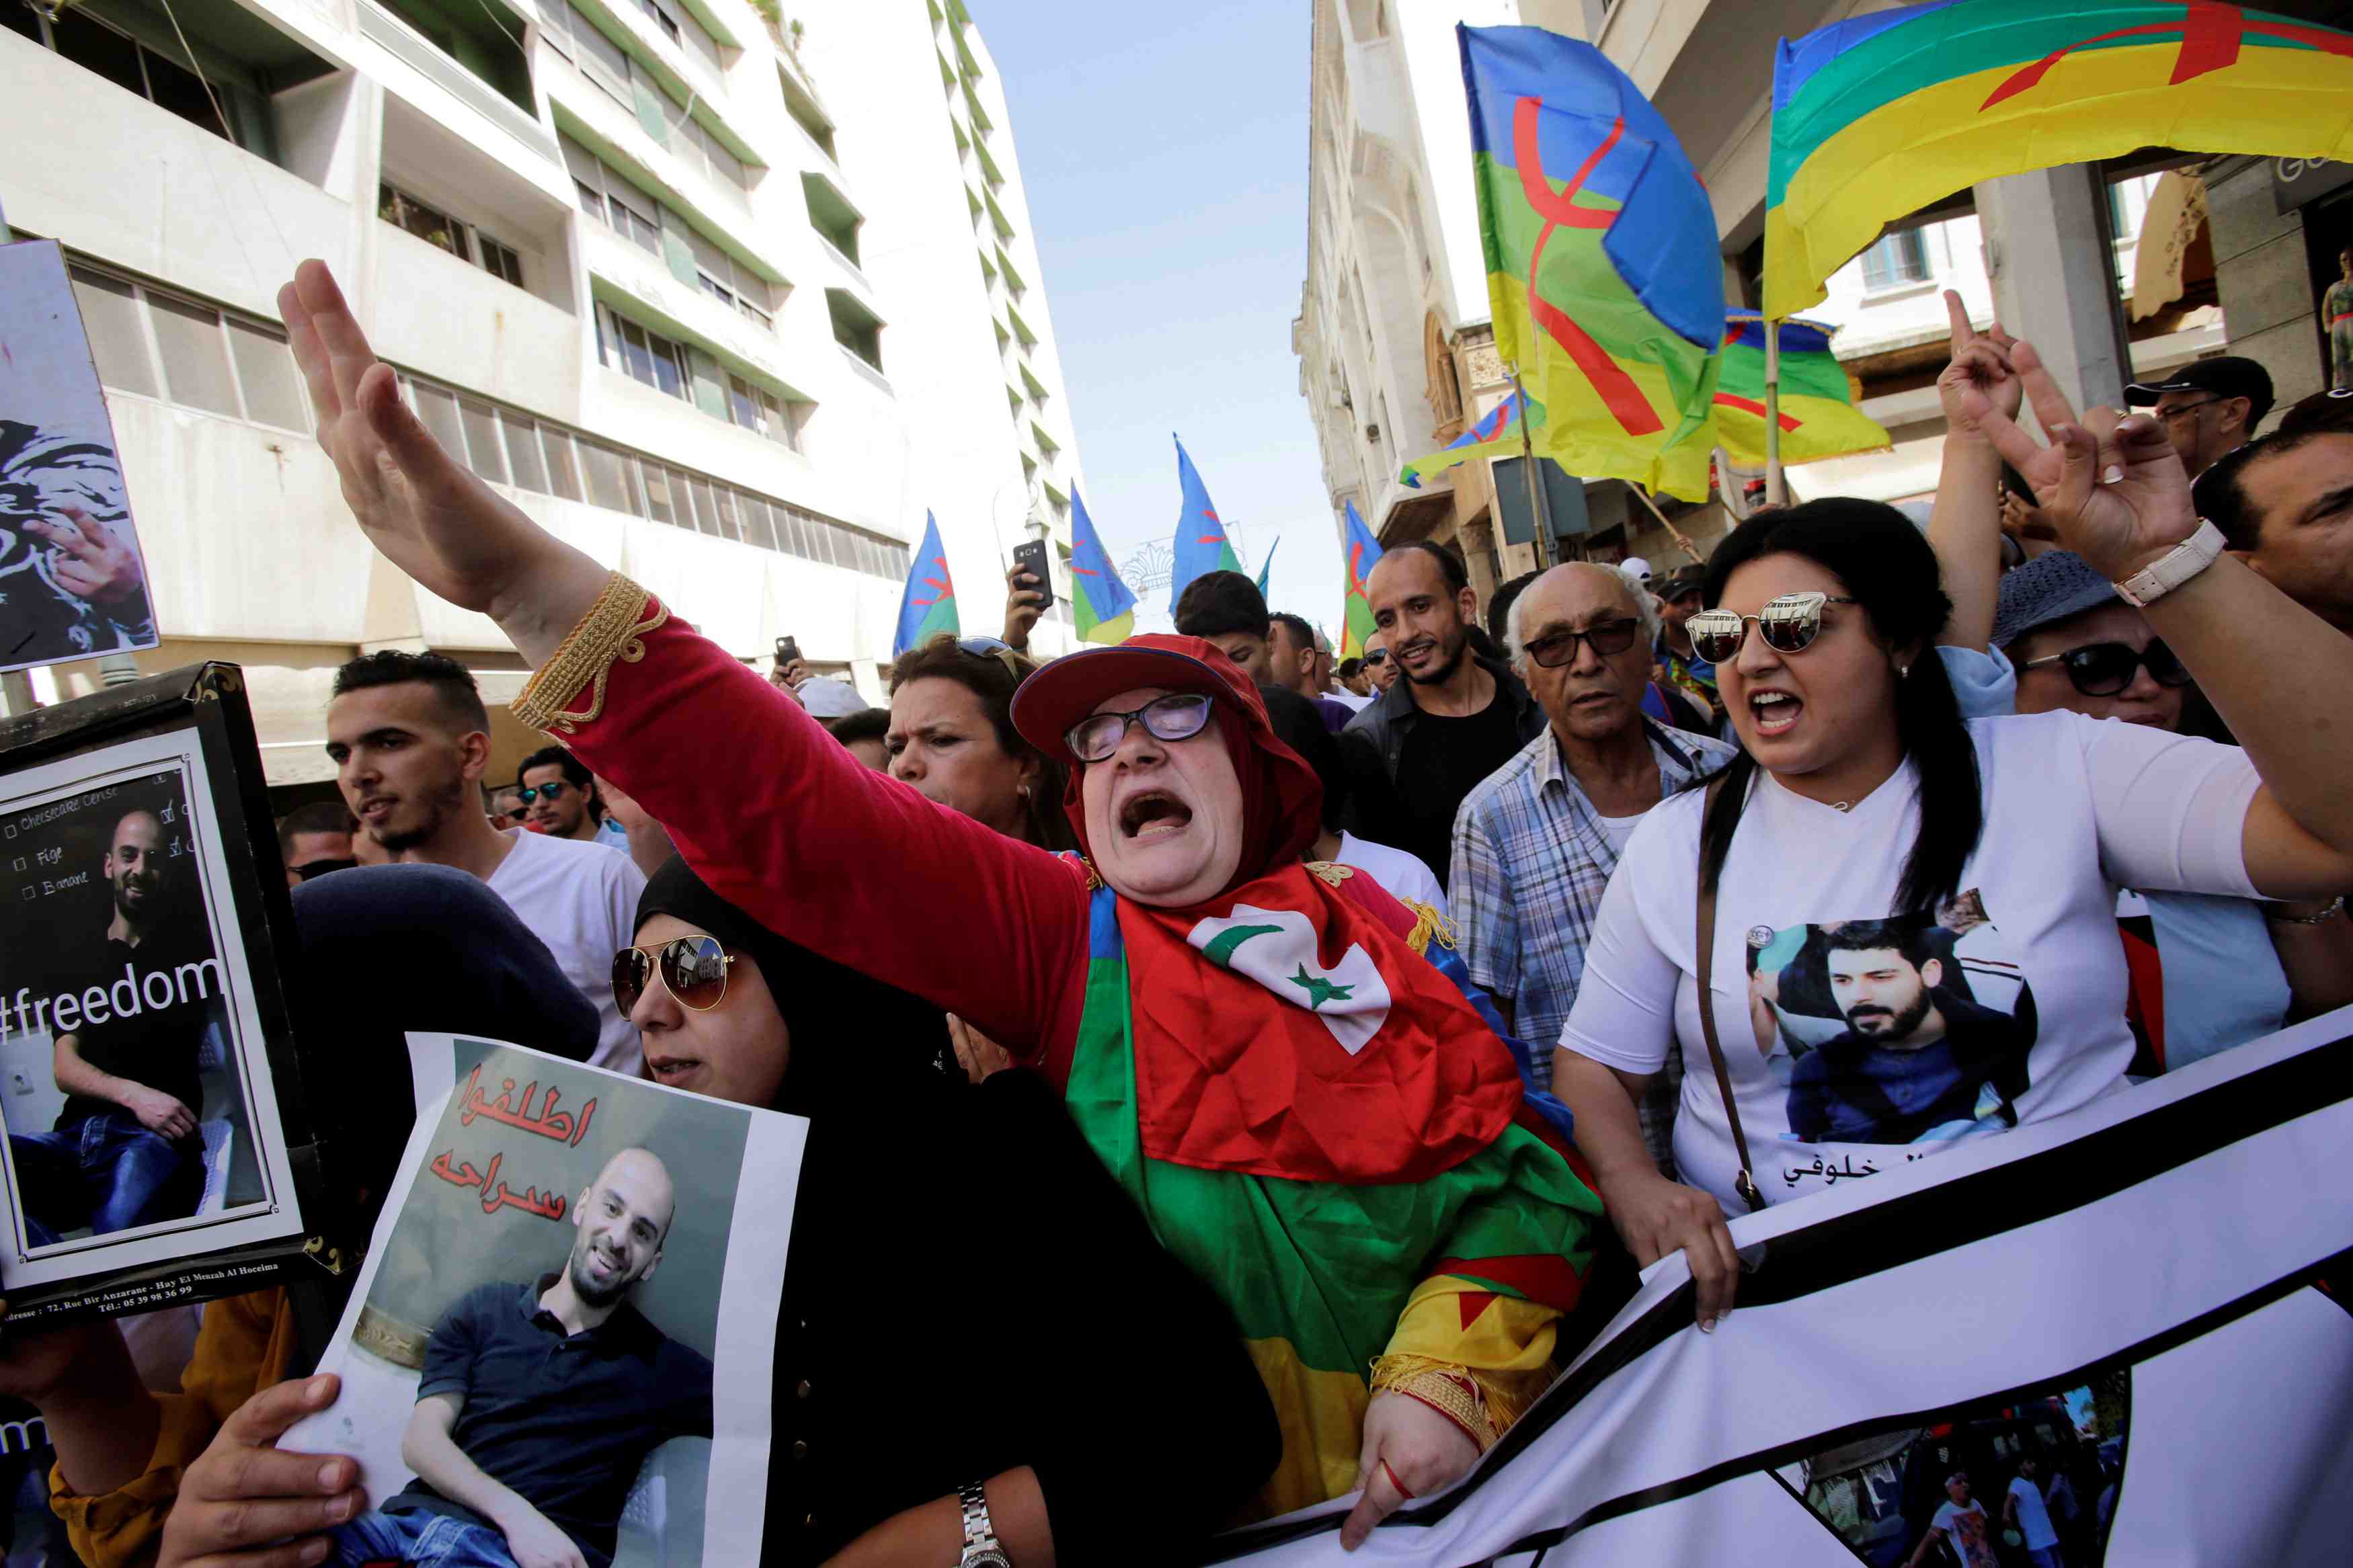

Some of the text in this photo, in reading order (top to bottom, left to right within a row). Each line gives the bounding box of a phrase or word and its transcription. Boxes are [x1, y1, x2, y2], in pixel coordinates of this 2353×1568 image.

[43, 871, 90, 895] Banane
[64, 1301, 82, 1310] Rue
[83, 1296, 99, 1306] Bir
[103, 1286, 147, 1301] Anzarane
[156, 1278, 176, 1290] Hay
[180, 1275, 192, 1284] El
[227, 1268, 237, 1277] Al
[239, 1262, 278, 1276] Hoceima
[124, 1298, 134, 1307] 05
[138, 1295, 149, 1305] 39
[151, 1292, 163, 1302] 98
[165, 1289, 177, 1299] 36
[180, 1285, 192, 1296] 99
